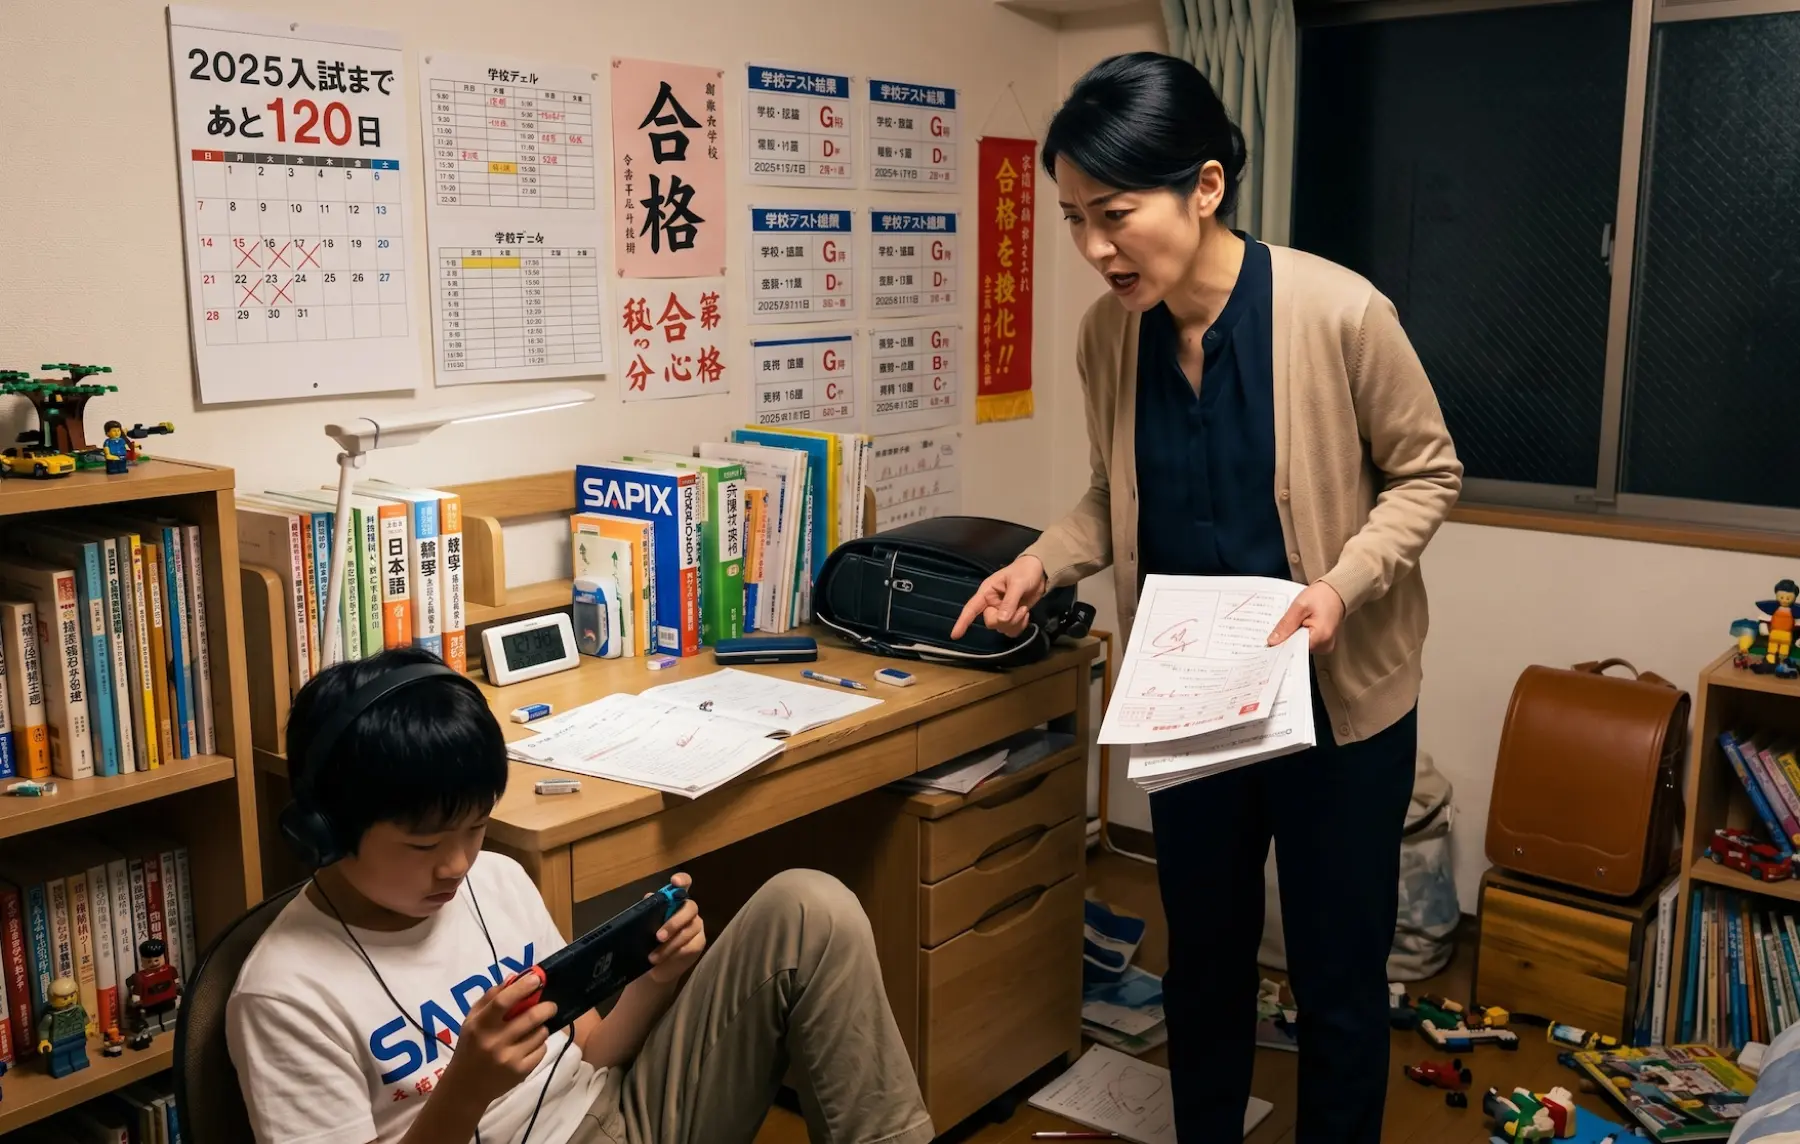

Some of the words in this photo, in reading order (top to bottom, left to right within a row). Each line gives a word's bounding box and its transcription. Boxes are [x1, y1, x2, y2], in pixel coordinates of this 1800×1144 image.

[188, 48, 394, 96] 2025入試まで
[761, 71, 837, 94] 学校テスト結果
[204, 152, 212, 160] 日
[237, 153, 244, 162] 月
[326, 158, 333, 166] 木
[228, 165, 233, 175] 1
[258, 166, 265, 176] 2
[288, 167, 294, 177] 3
[318, 169, 324, 178] 4
[346, 170, 352, 180] 5
[374, 171, 380, 181] 6
[638, 81, 706, 254] 合格
[197, 201, 204, 211] 7
[229, 202, 237, 212] 8
[260, 203, 267, 212] 9
[290, 203, 302, 213] 10
[320, 204, 330, 214] 11
[349, 205, 360, 214] 12
[376, 206, 387, 215] 13
[201, 239, 213, 247] 14
[233, 239, 245, 247] 15
[264, 239, 276, 248] 16
[294, 239, 305, 248] 17
[322, 239, 334, 248] 18
[351, 240, 362, 248] 19
[377, 240, 389, 248] 20
[203, 275, 215, 284] 21
[234, 275, 247, 284] 22
[265, 275, 278, 283] 23
[295, 274, 307, 283] 24
[324, 274, 336, 283] 25
[352, 274, 364, 282] 26
[379, 273, 390, 282] 27
[206, 311, 220, 321] 28
[237, 310, 249, 320] 29
[268, 309, 280, 319] 30
[297, 309, 309, 318] 31
[583, 477, 673, 516] SAPIX
[388, 537, 405, 595] 日本語
